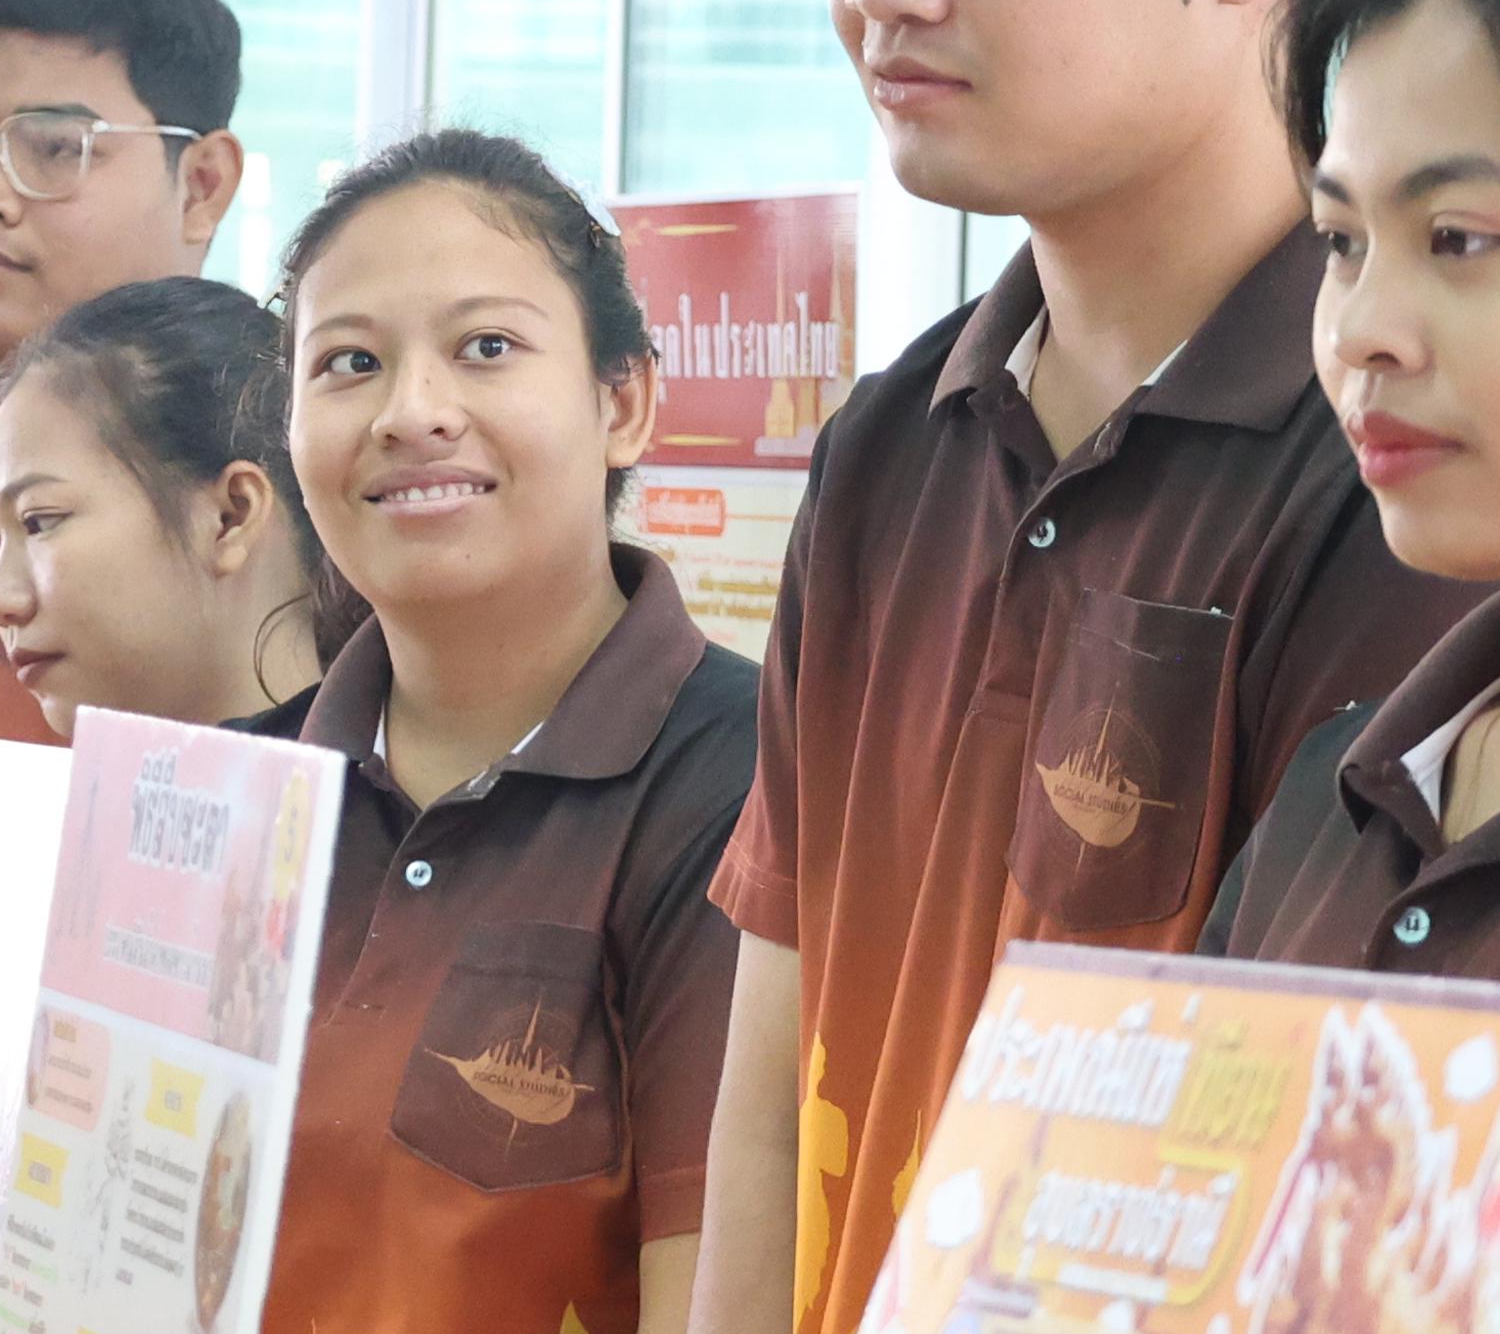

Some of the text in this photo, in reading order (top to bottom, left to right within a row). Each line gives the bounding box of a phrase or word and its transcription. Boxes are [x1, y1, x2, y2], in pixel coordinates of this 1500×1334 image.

[650, 291, 839, 405] สุดในประเทศไทย
